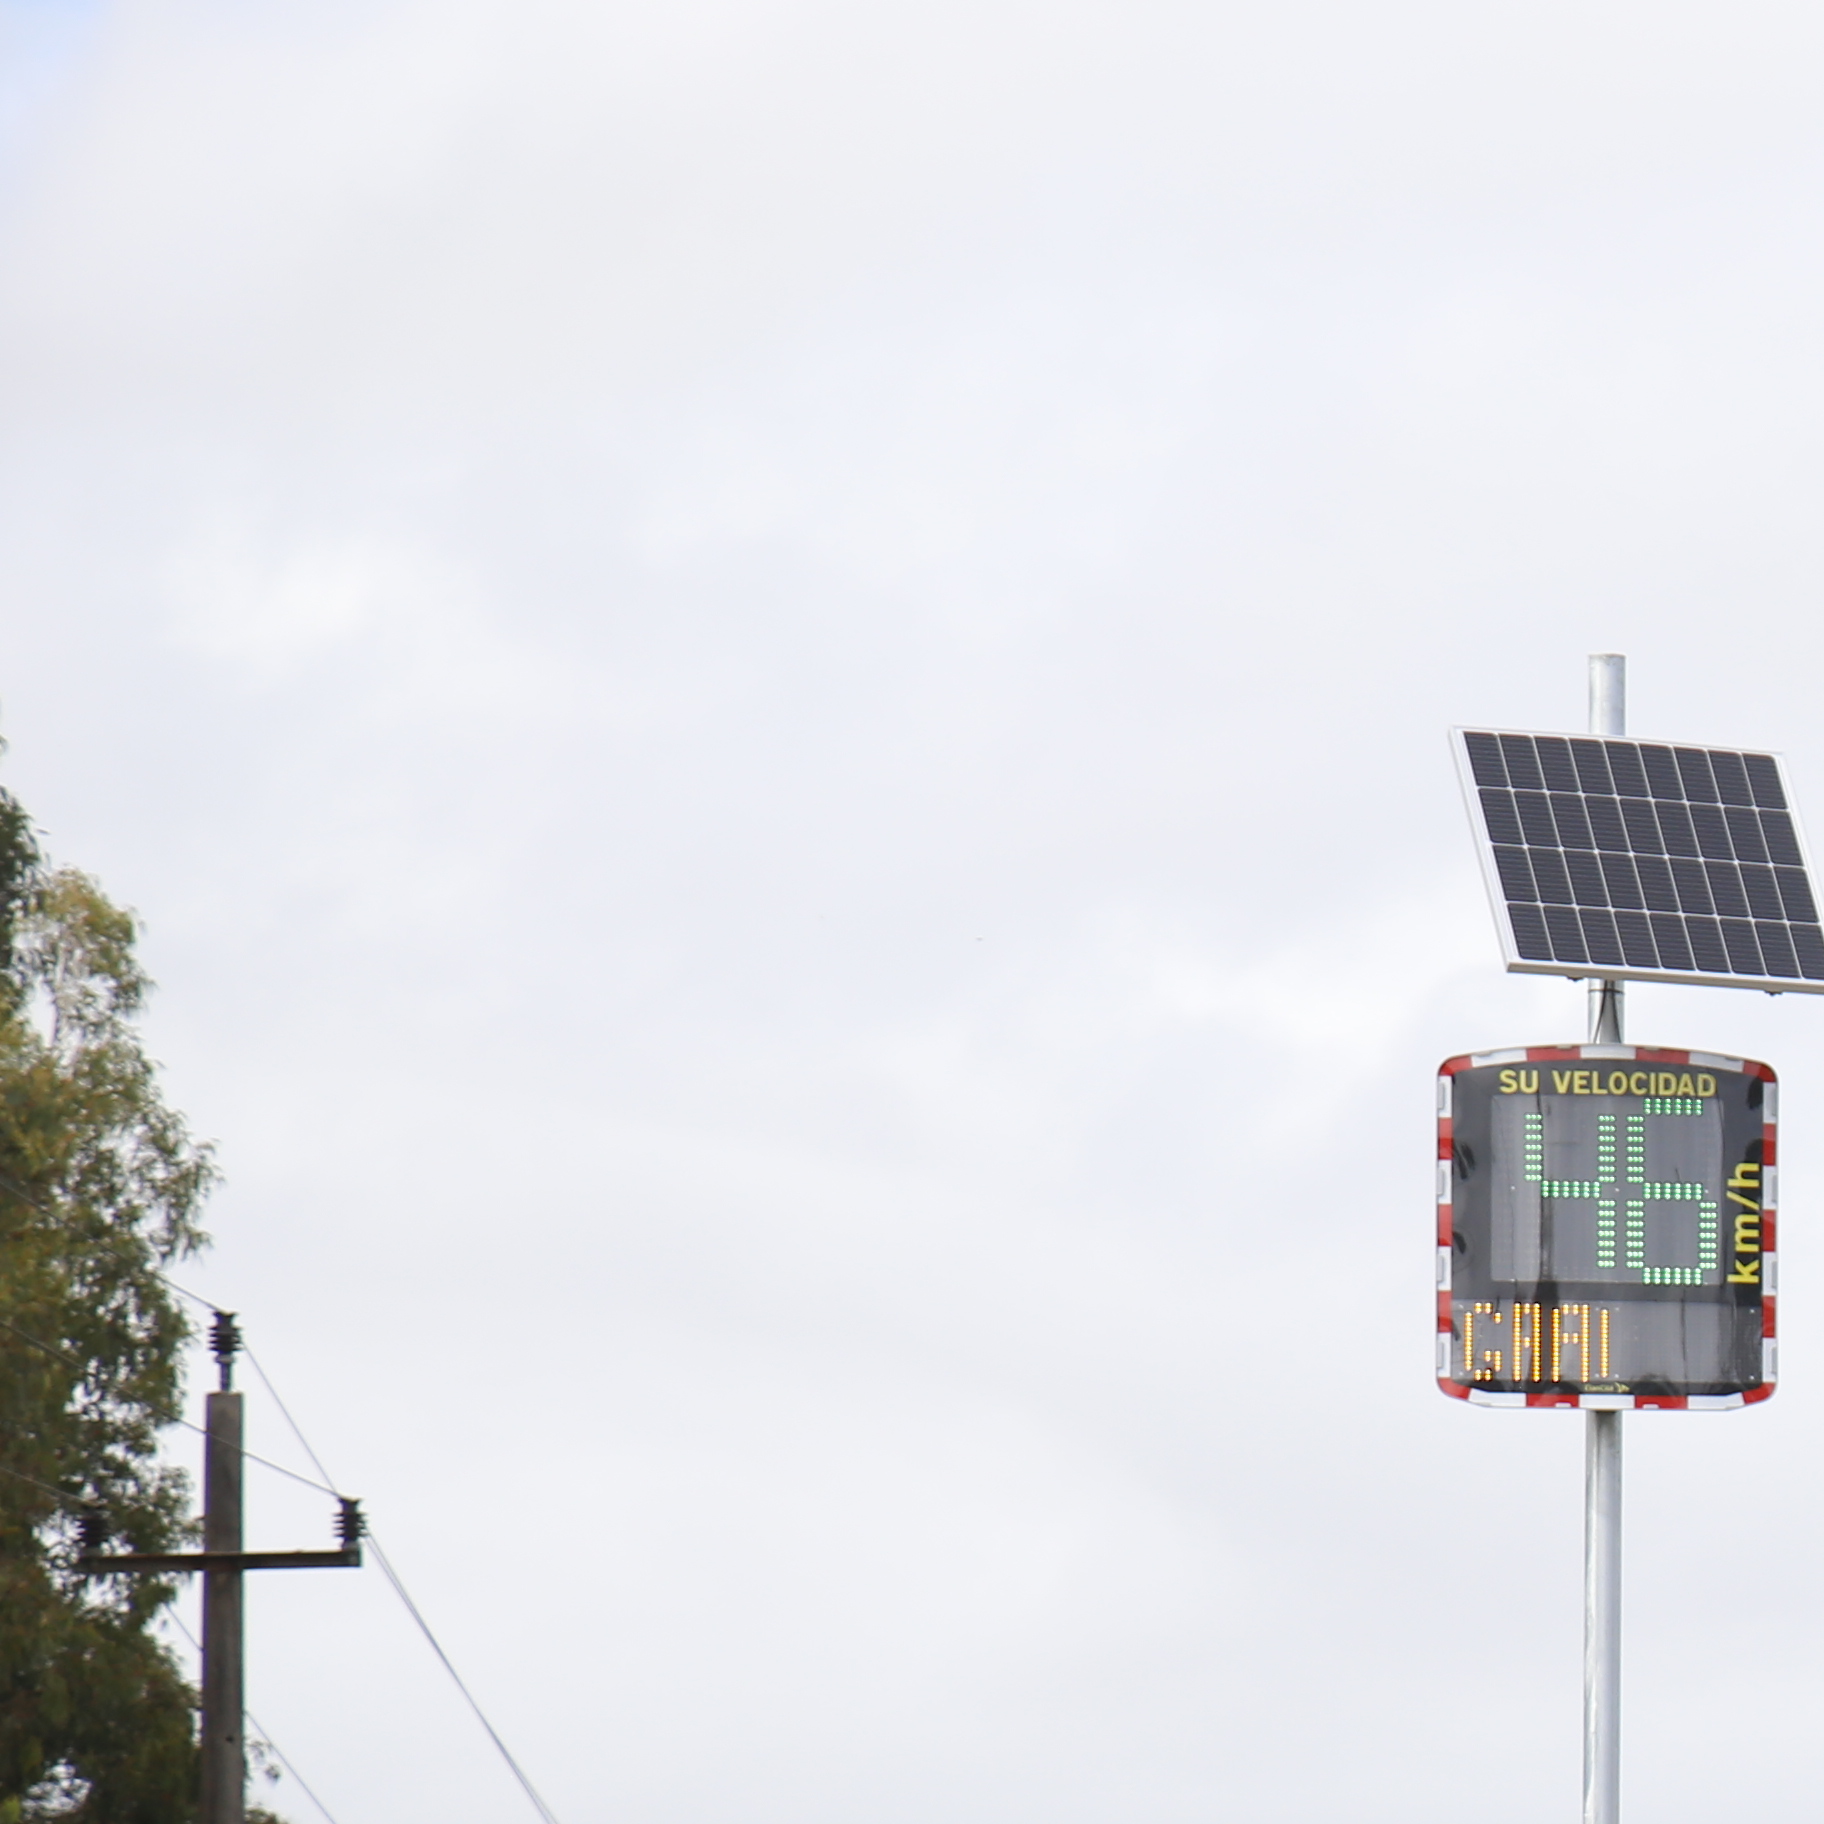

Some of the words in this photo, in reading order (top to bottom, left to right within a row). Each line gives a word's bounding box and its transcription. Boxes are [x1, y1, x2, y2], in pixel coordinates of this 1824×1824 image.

[1499, 1069, 1539, 1095] SU
[1551, 1070, 1717, 1097] VELOCIDAD
[1523, 1097, 1719, 1286] 46
[1726, 1161, 1761, 1285] km/h
